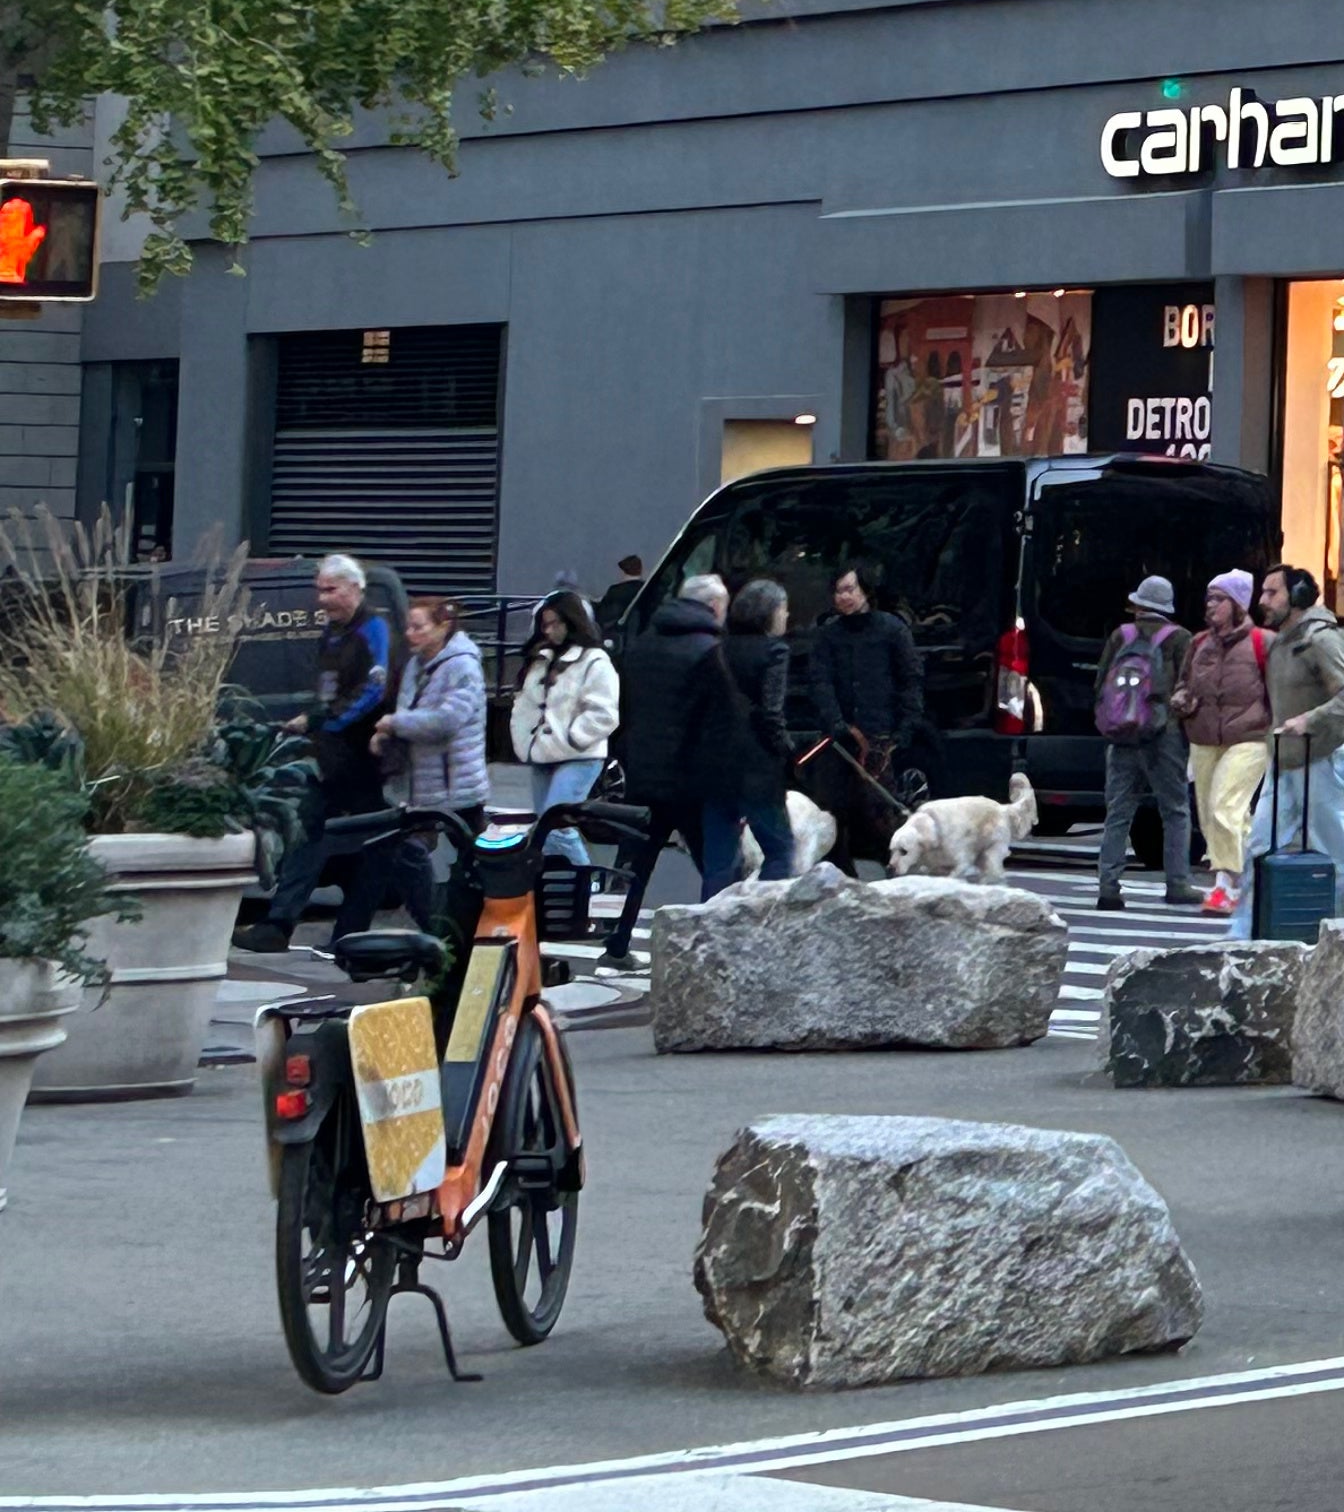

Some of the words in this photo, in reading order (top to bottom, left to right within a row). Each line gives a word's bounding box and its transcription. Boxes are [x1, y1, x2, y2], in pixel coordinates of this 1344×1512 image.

[1163, 304, 1214, 348] BOR
[1126, 396, 1212, 440] DETRO
[168, 615, 220, 635] THE
